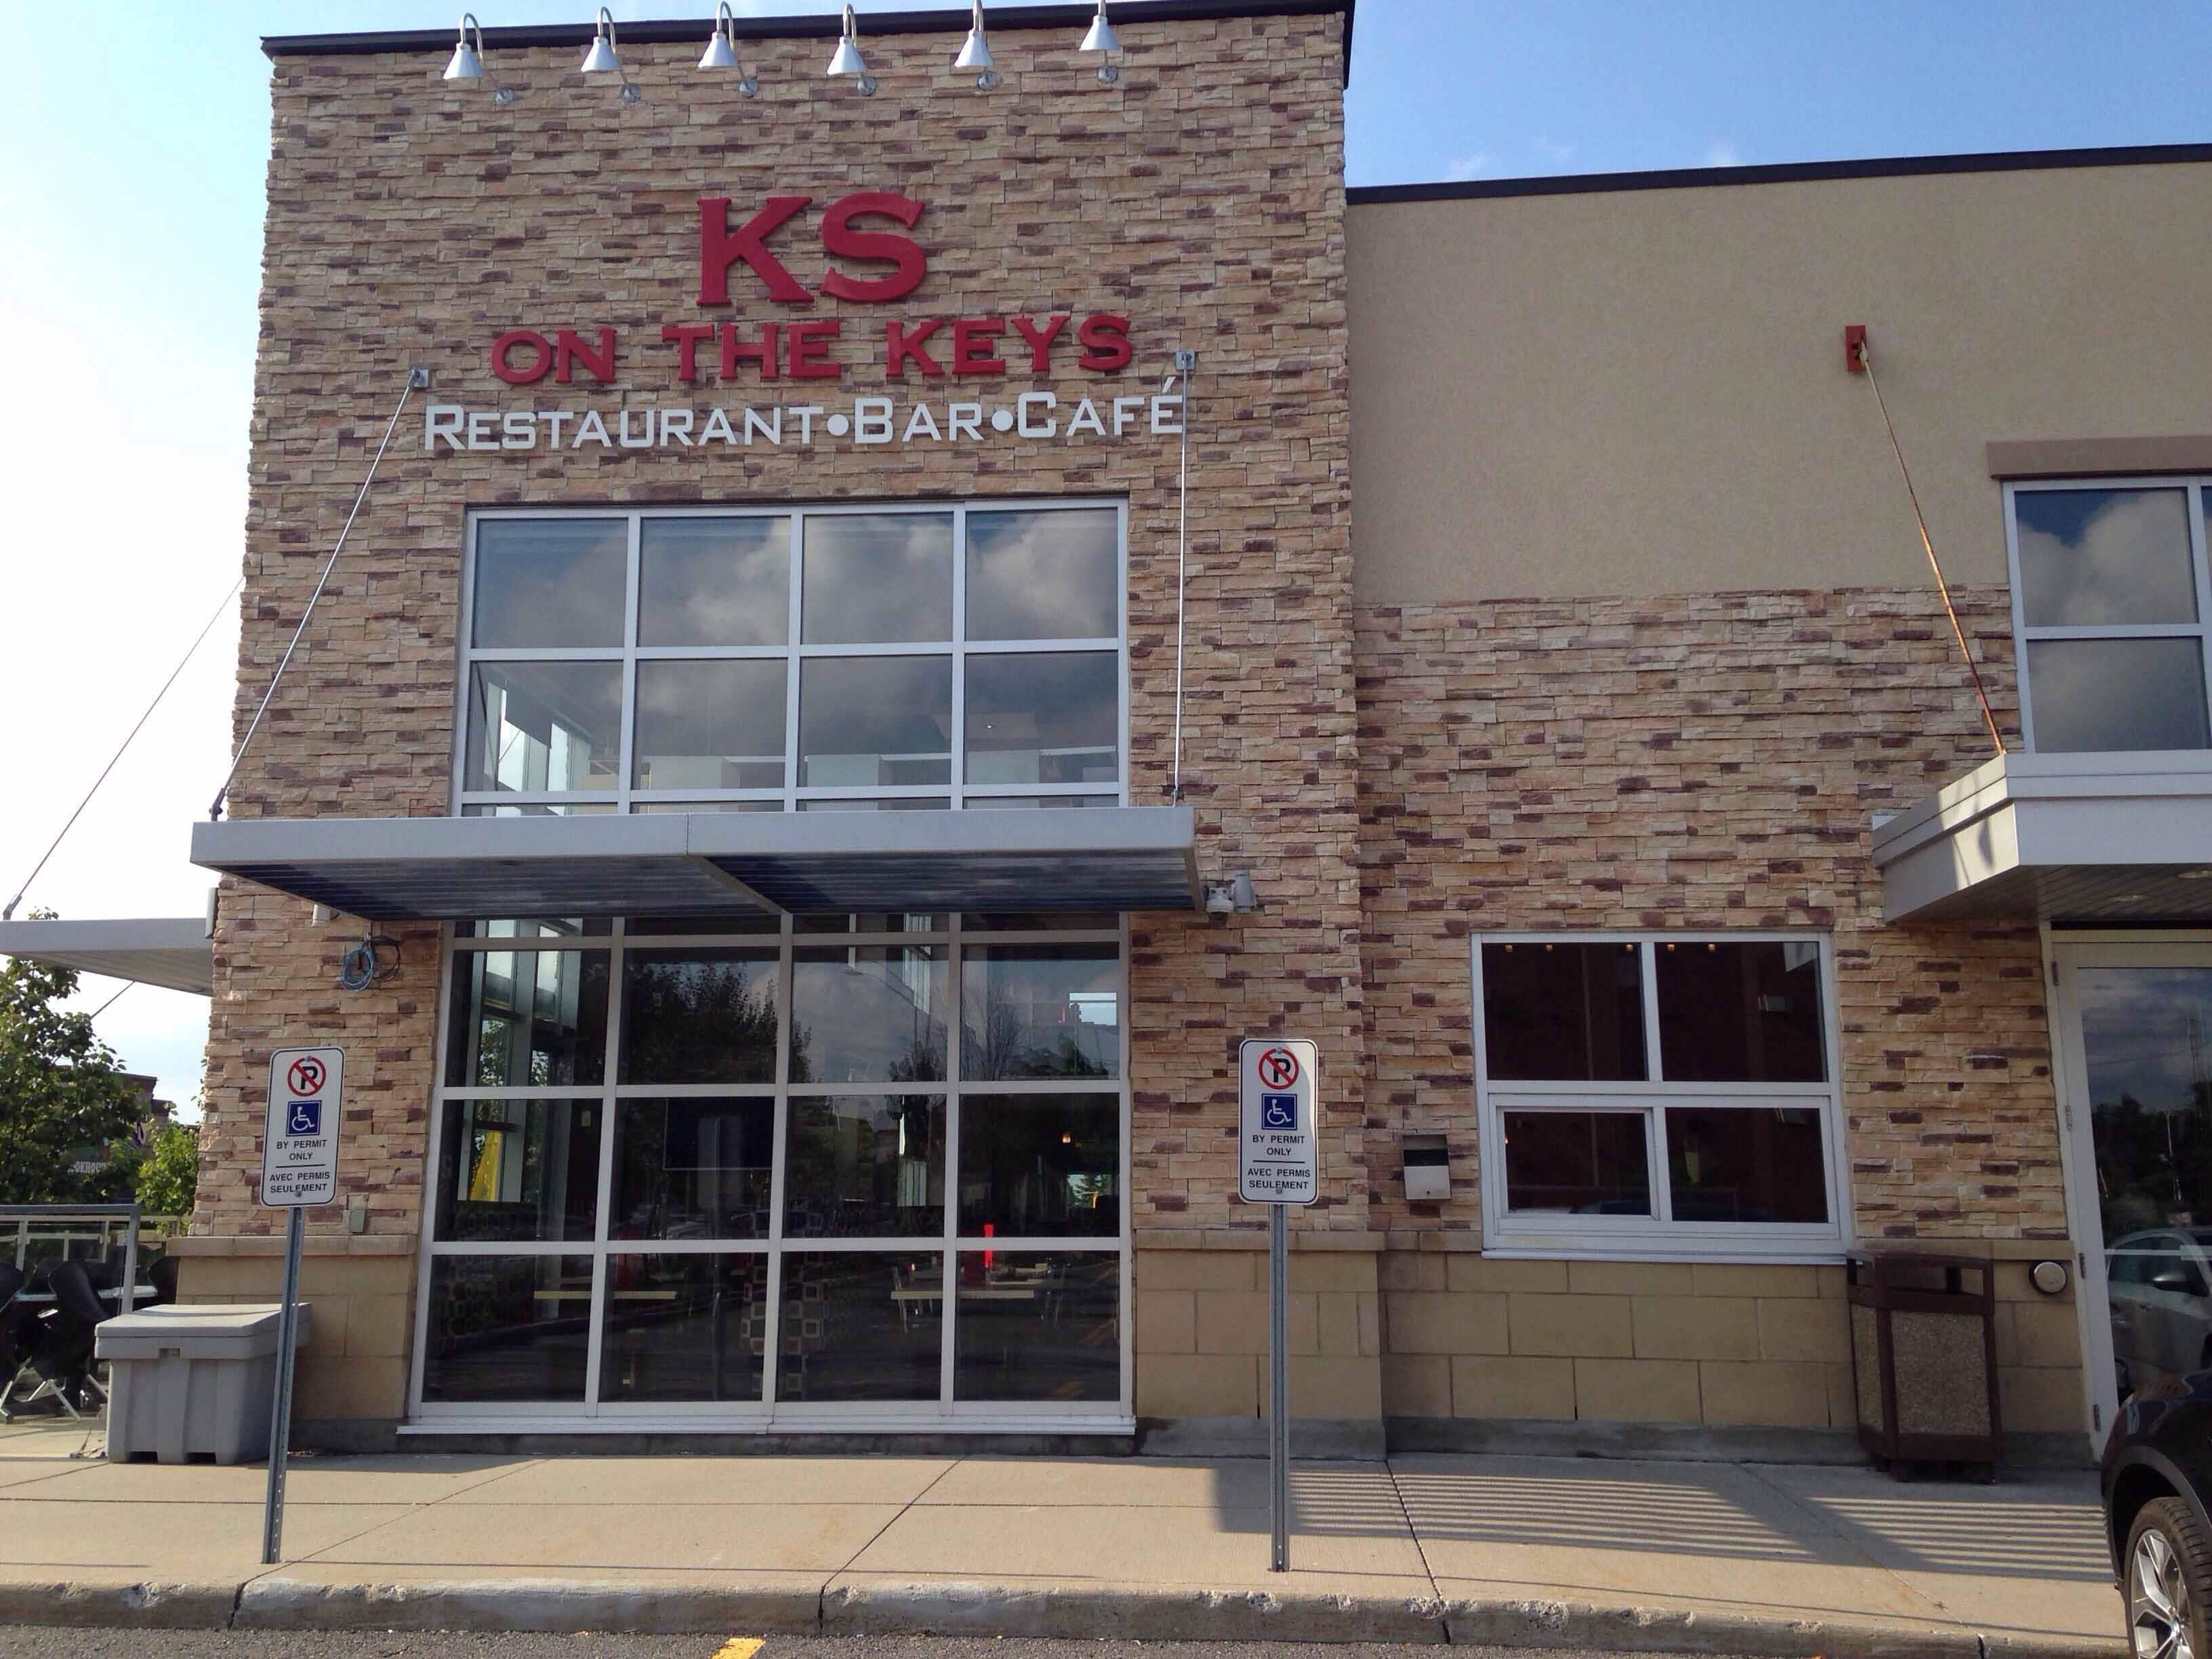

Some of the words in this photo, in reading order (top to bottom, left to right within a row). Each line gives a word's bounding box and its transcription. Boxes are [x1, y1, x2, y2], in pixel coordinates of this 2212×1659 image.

[696, 192, 926, 306] KS
[491, 329, 617, 385] ON
[661, 320, 841, 381] THE
[886, 314, 1132, 377] KEYS
[424, 405, 824, 451] RESTAURANT
[276, 1141, 289, 1149] BY
[293, 1139, 328, 1148] PERMIT
[1252, 1134, 1265, 1143] BY
[1271, 1135, 1305, 1144] PERMIT
[1267, 1147, 1292, 1155] ONLY
[289, 1152, 313, 1161] ONLY
[270, 1173, 293, 1181] AVEC
[298, 1172, 330, 1181] PERMIS
[1248, 1168, 1272, 1176] AVEC
[1277, 1168, 1311, 1177] PERMIS
[270, 1183, 328, 1193] SEULEMENT
[1249, 1179, 1309, 1189] SEULEMENT
